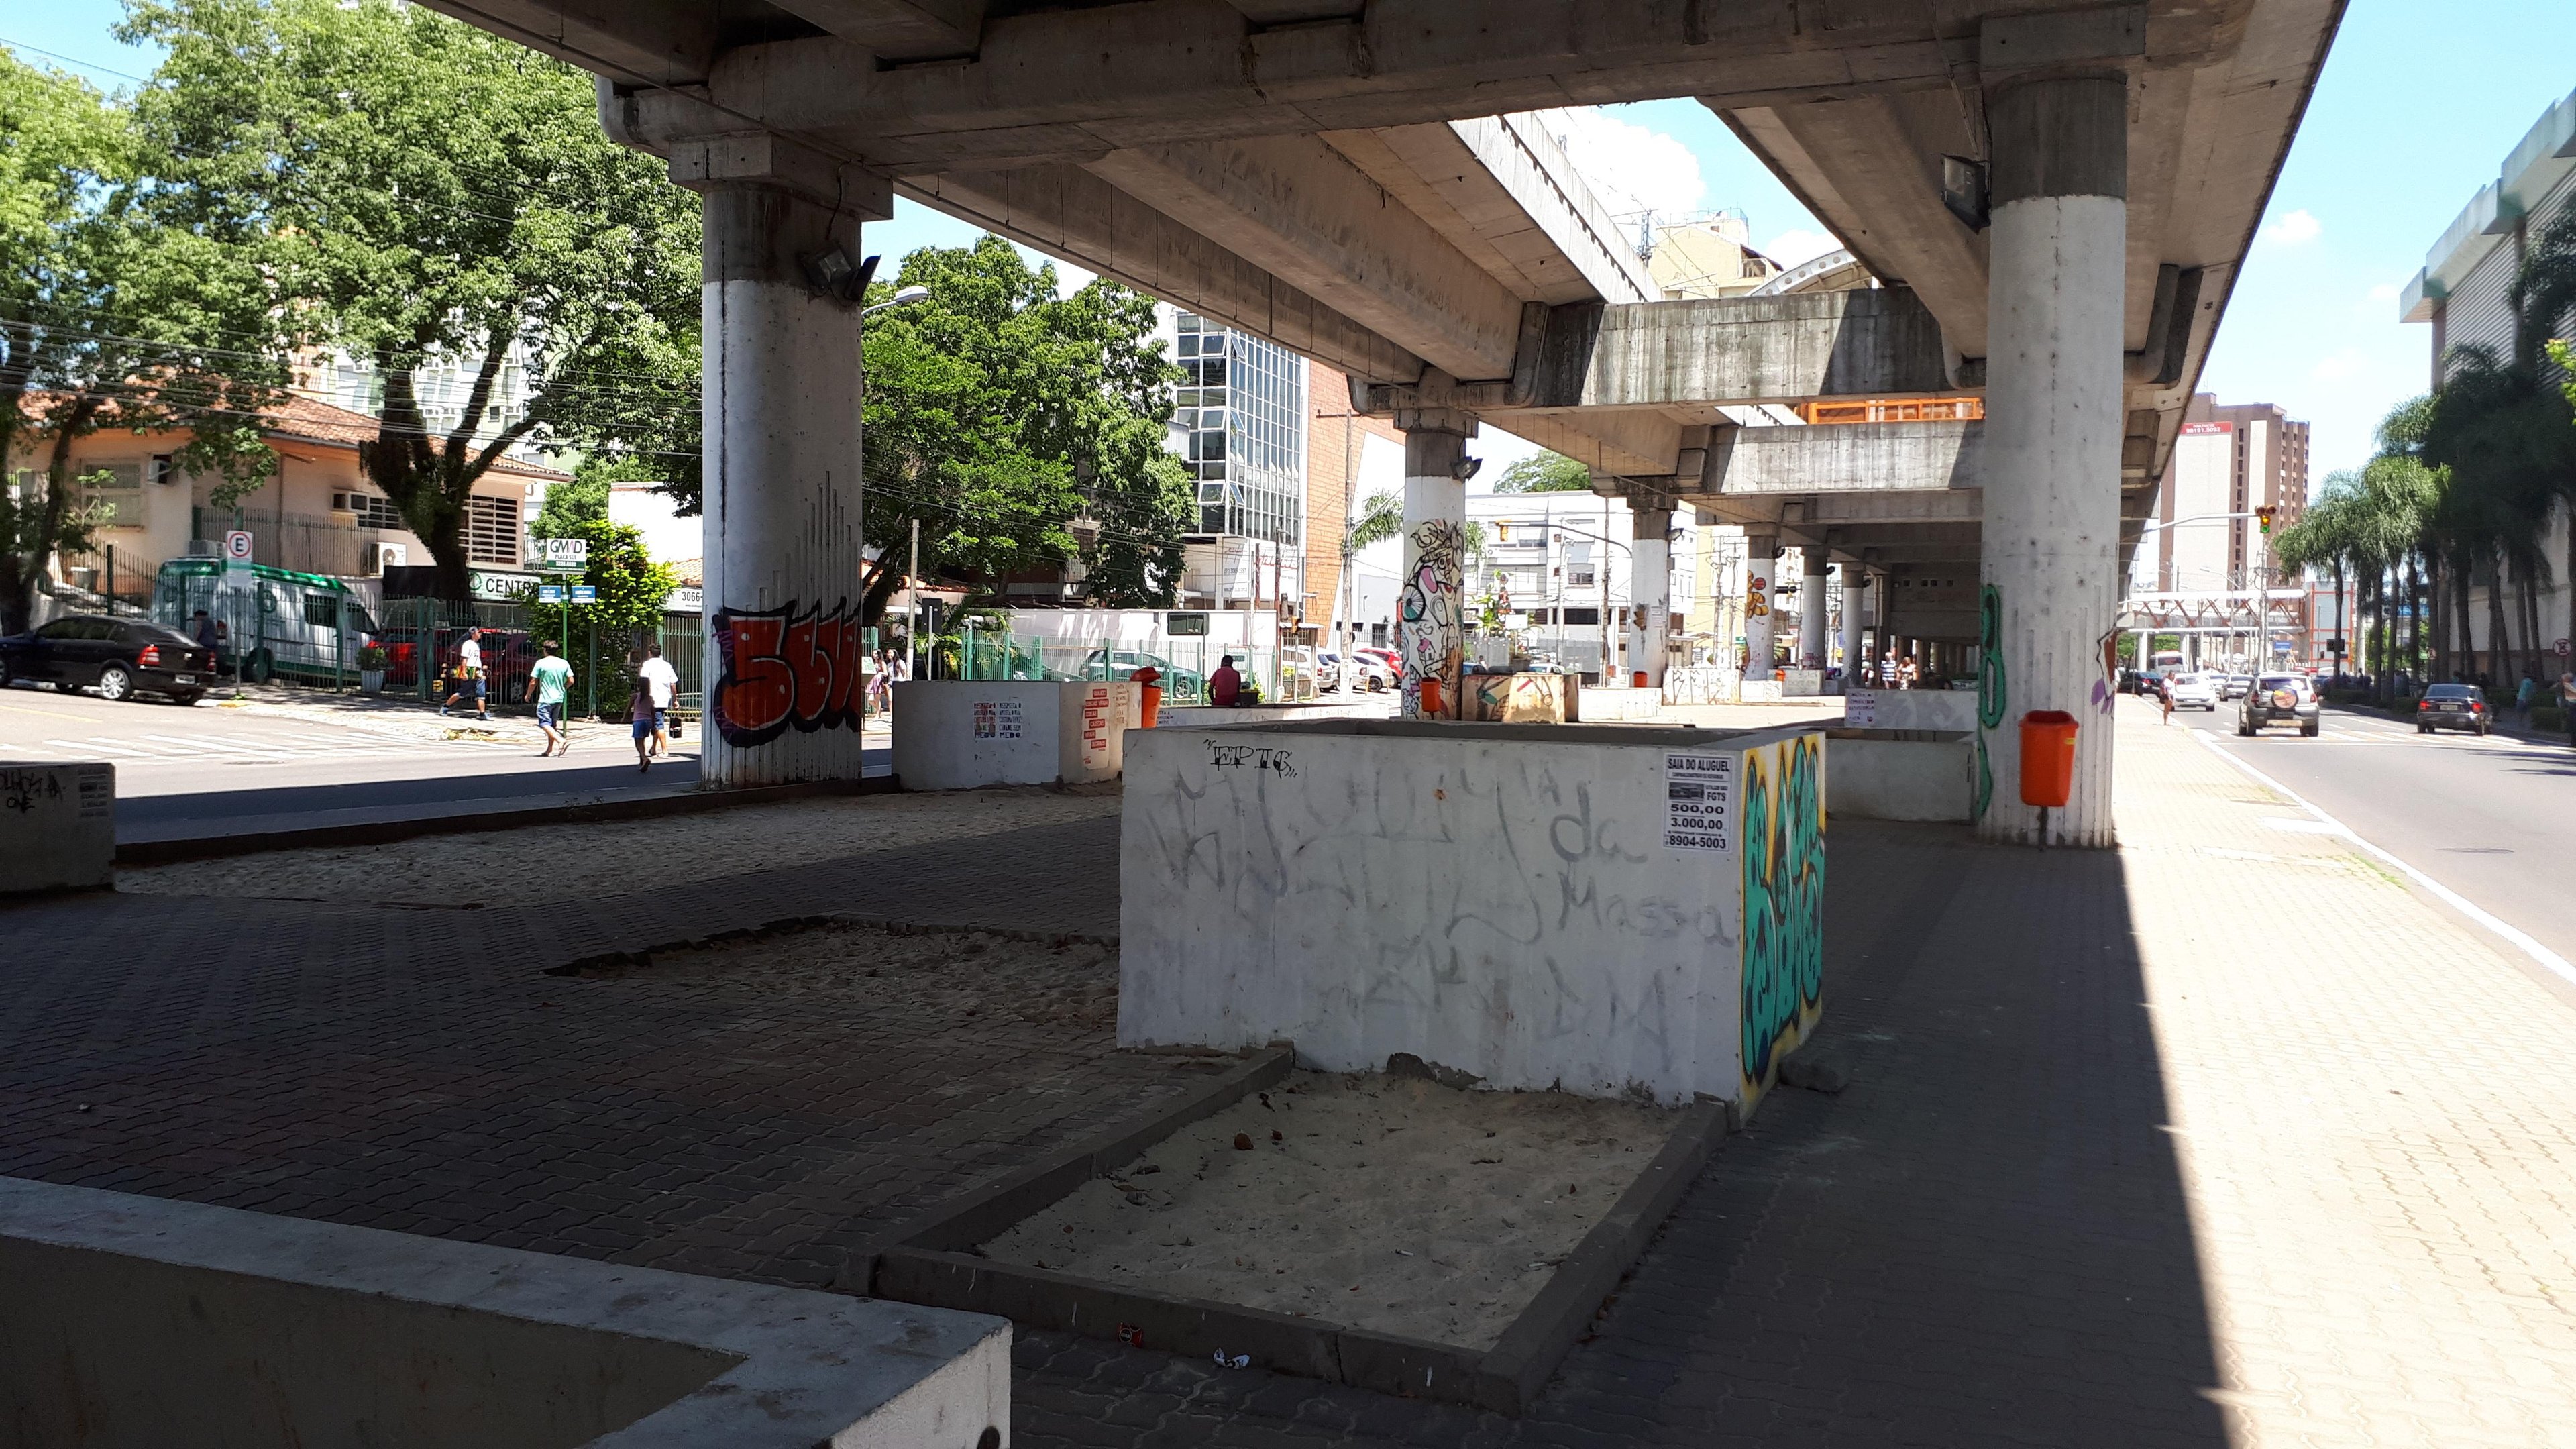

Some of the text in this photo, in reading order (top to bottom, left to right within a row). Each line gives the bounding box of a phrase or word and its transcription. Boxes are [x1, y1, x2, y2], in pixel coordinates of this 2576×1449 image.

[235, 537, 244, 552] E
[1668, 757, 1730, 772] SAIA DO ALUGUEL
[1706, 792, 1726, 802] FGTS
[1670, 804, 1724, 815] 500,00
[1670, 817, 1723, 831] 3.000,00
[1669, 835, 1726, 849] 8904-5003
